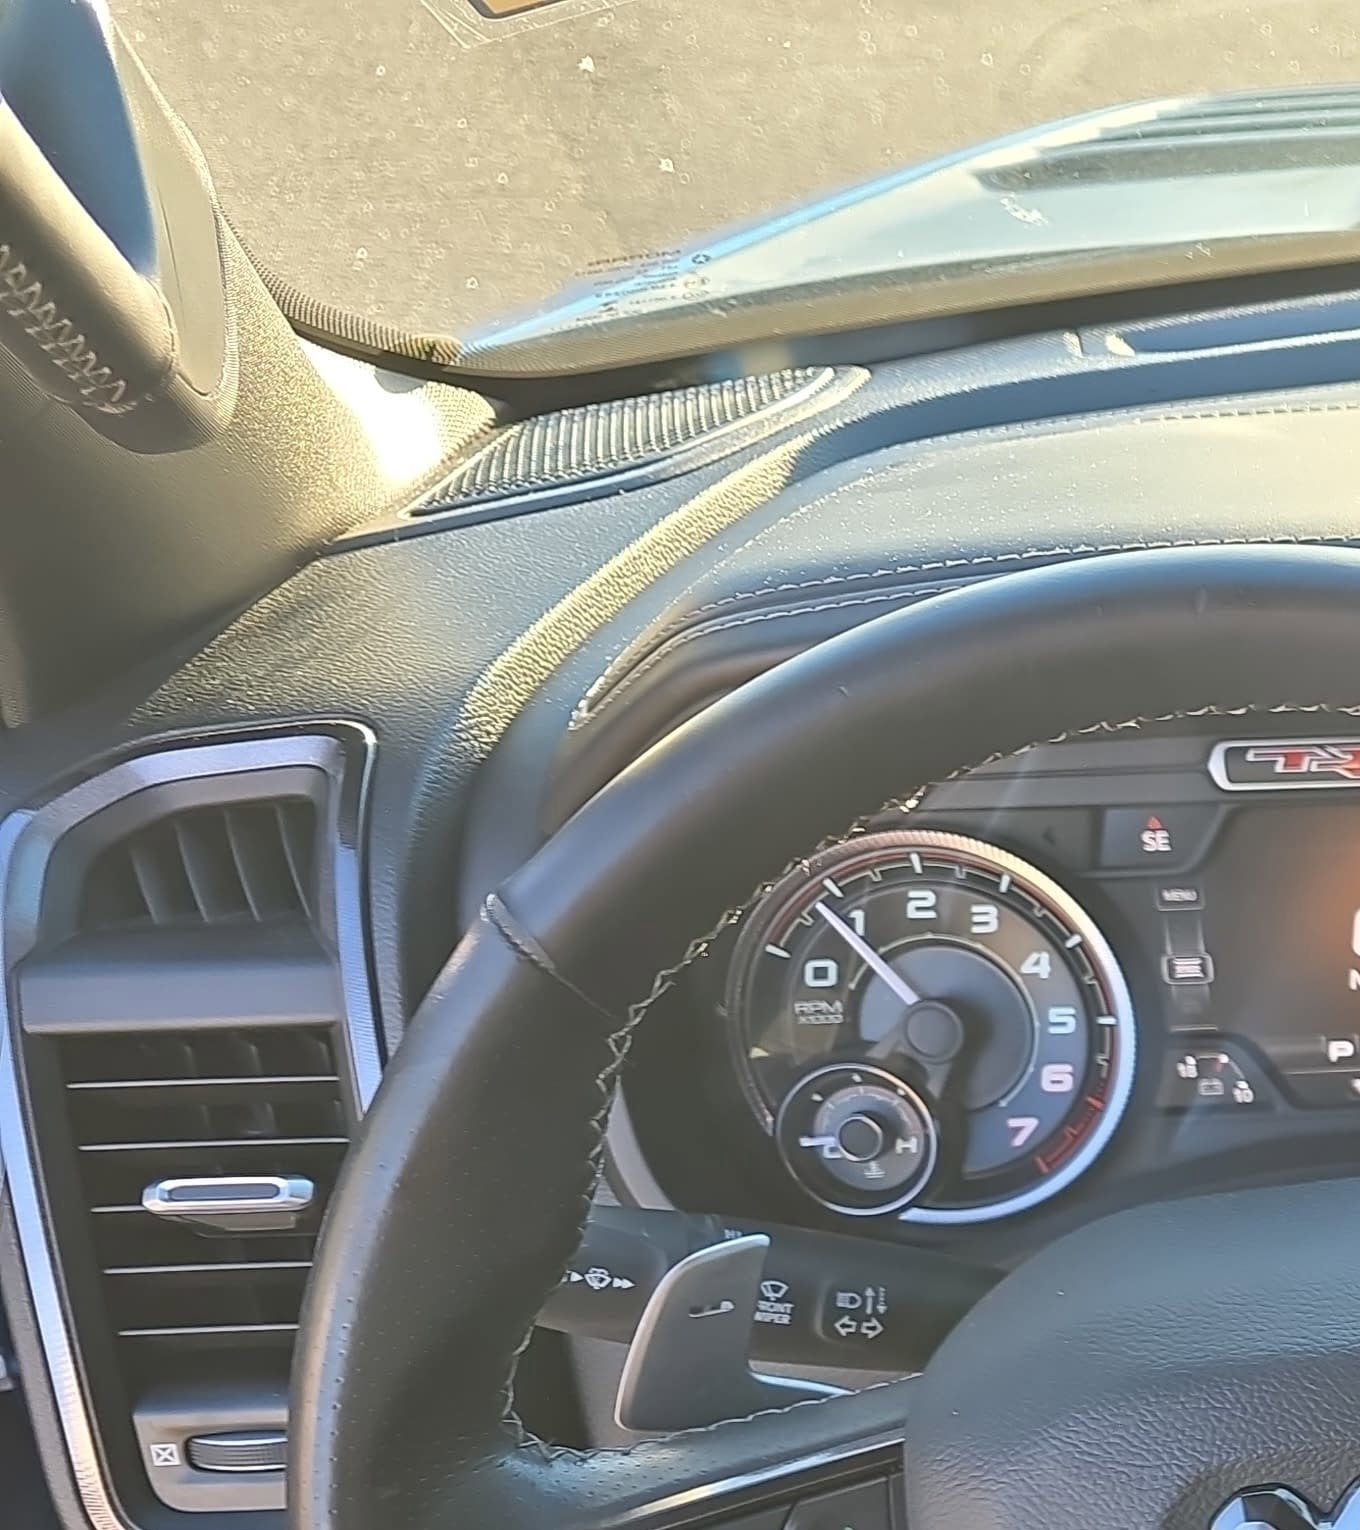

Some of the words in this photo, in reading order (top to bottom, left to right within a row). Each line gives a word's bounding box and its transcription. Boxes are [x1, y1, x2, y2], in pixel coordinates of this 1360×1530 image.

[1142, 831, 1171, 851] SE
[907, 890, 937, 919] 2
[848, 910, 865, 936] 1
[971, 905, 998, 934] 3
[805, 961, 837, 988] 0
[1020, 951, 1050, 979] 4
[794, 1000, 843, 1014] RPM
[1048, 1008, 1077, 1034] 5
[1041, 1065, 1074, 1093] 6
[896, 1137, 917, 1153] H
[1008, 1118, 1039, 1146] 7
